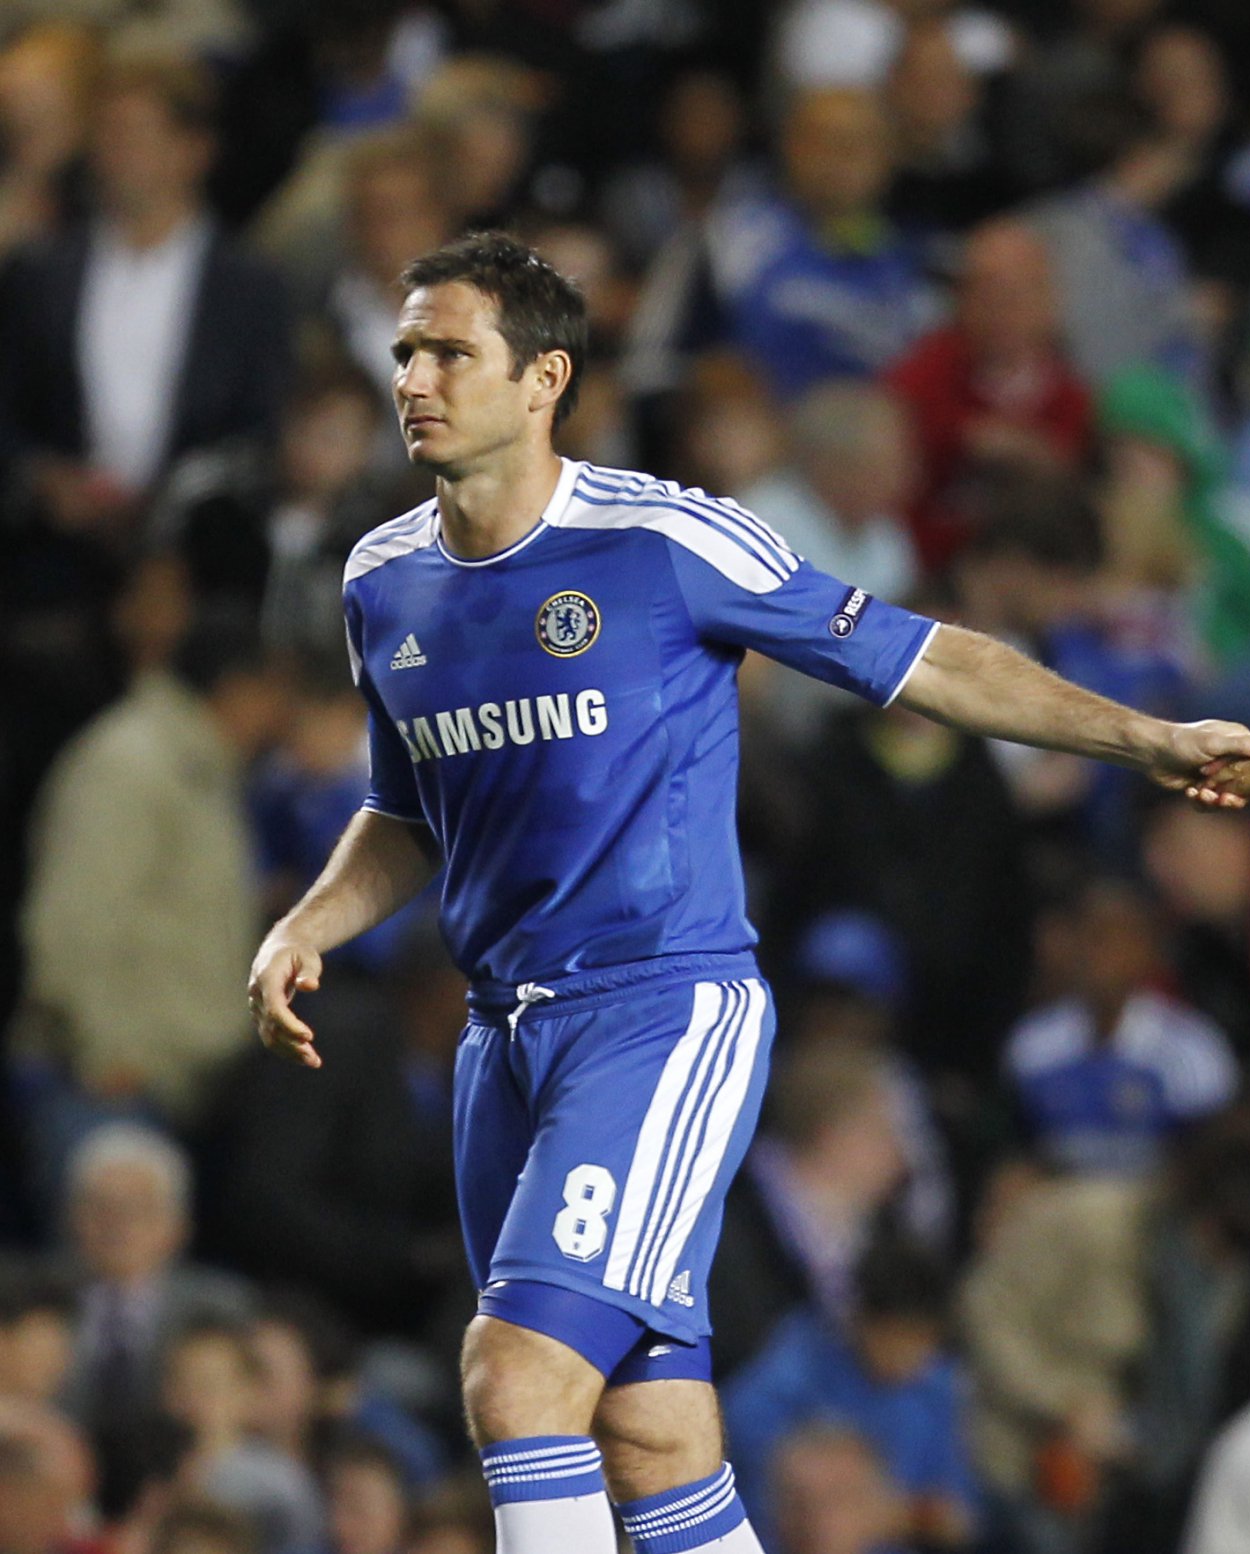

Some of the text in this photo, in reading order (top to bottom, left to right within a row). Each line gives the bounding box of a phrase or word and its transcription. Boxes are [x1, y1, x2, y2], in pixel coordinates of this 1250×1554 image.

[390, 655, 427, 670] adidas
[396, 689, 609, 764] SAMSUNG
[551, 1163, 618, 1264] 8
